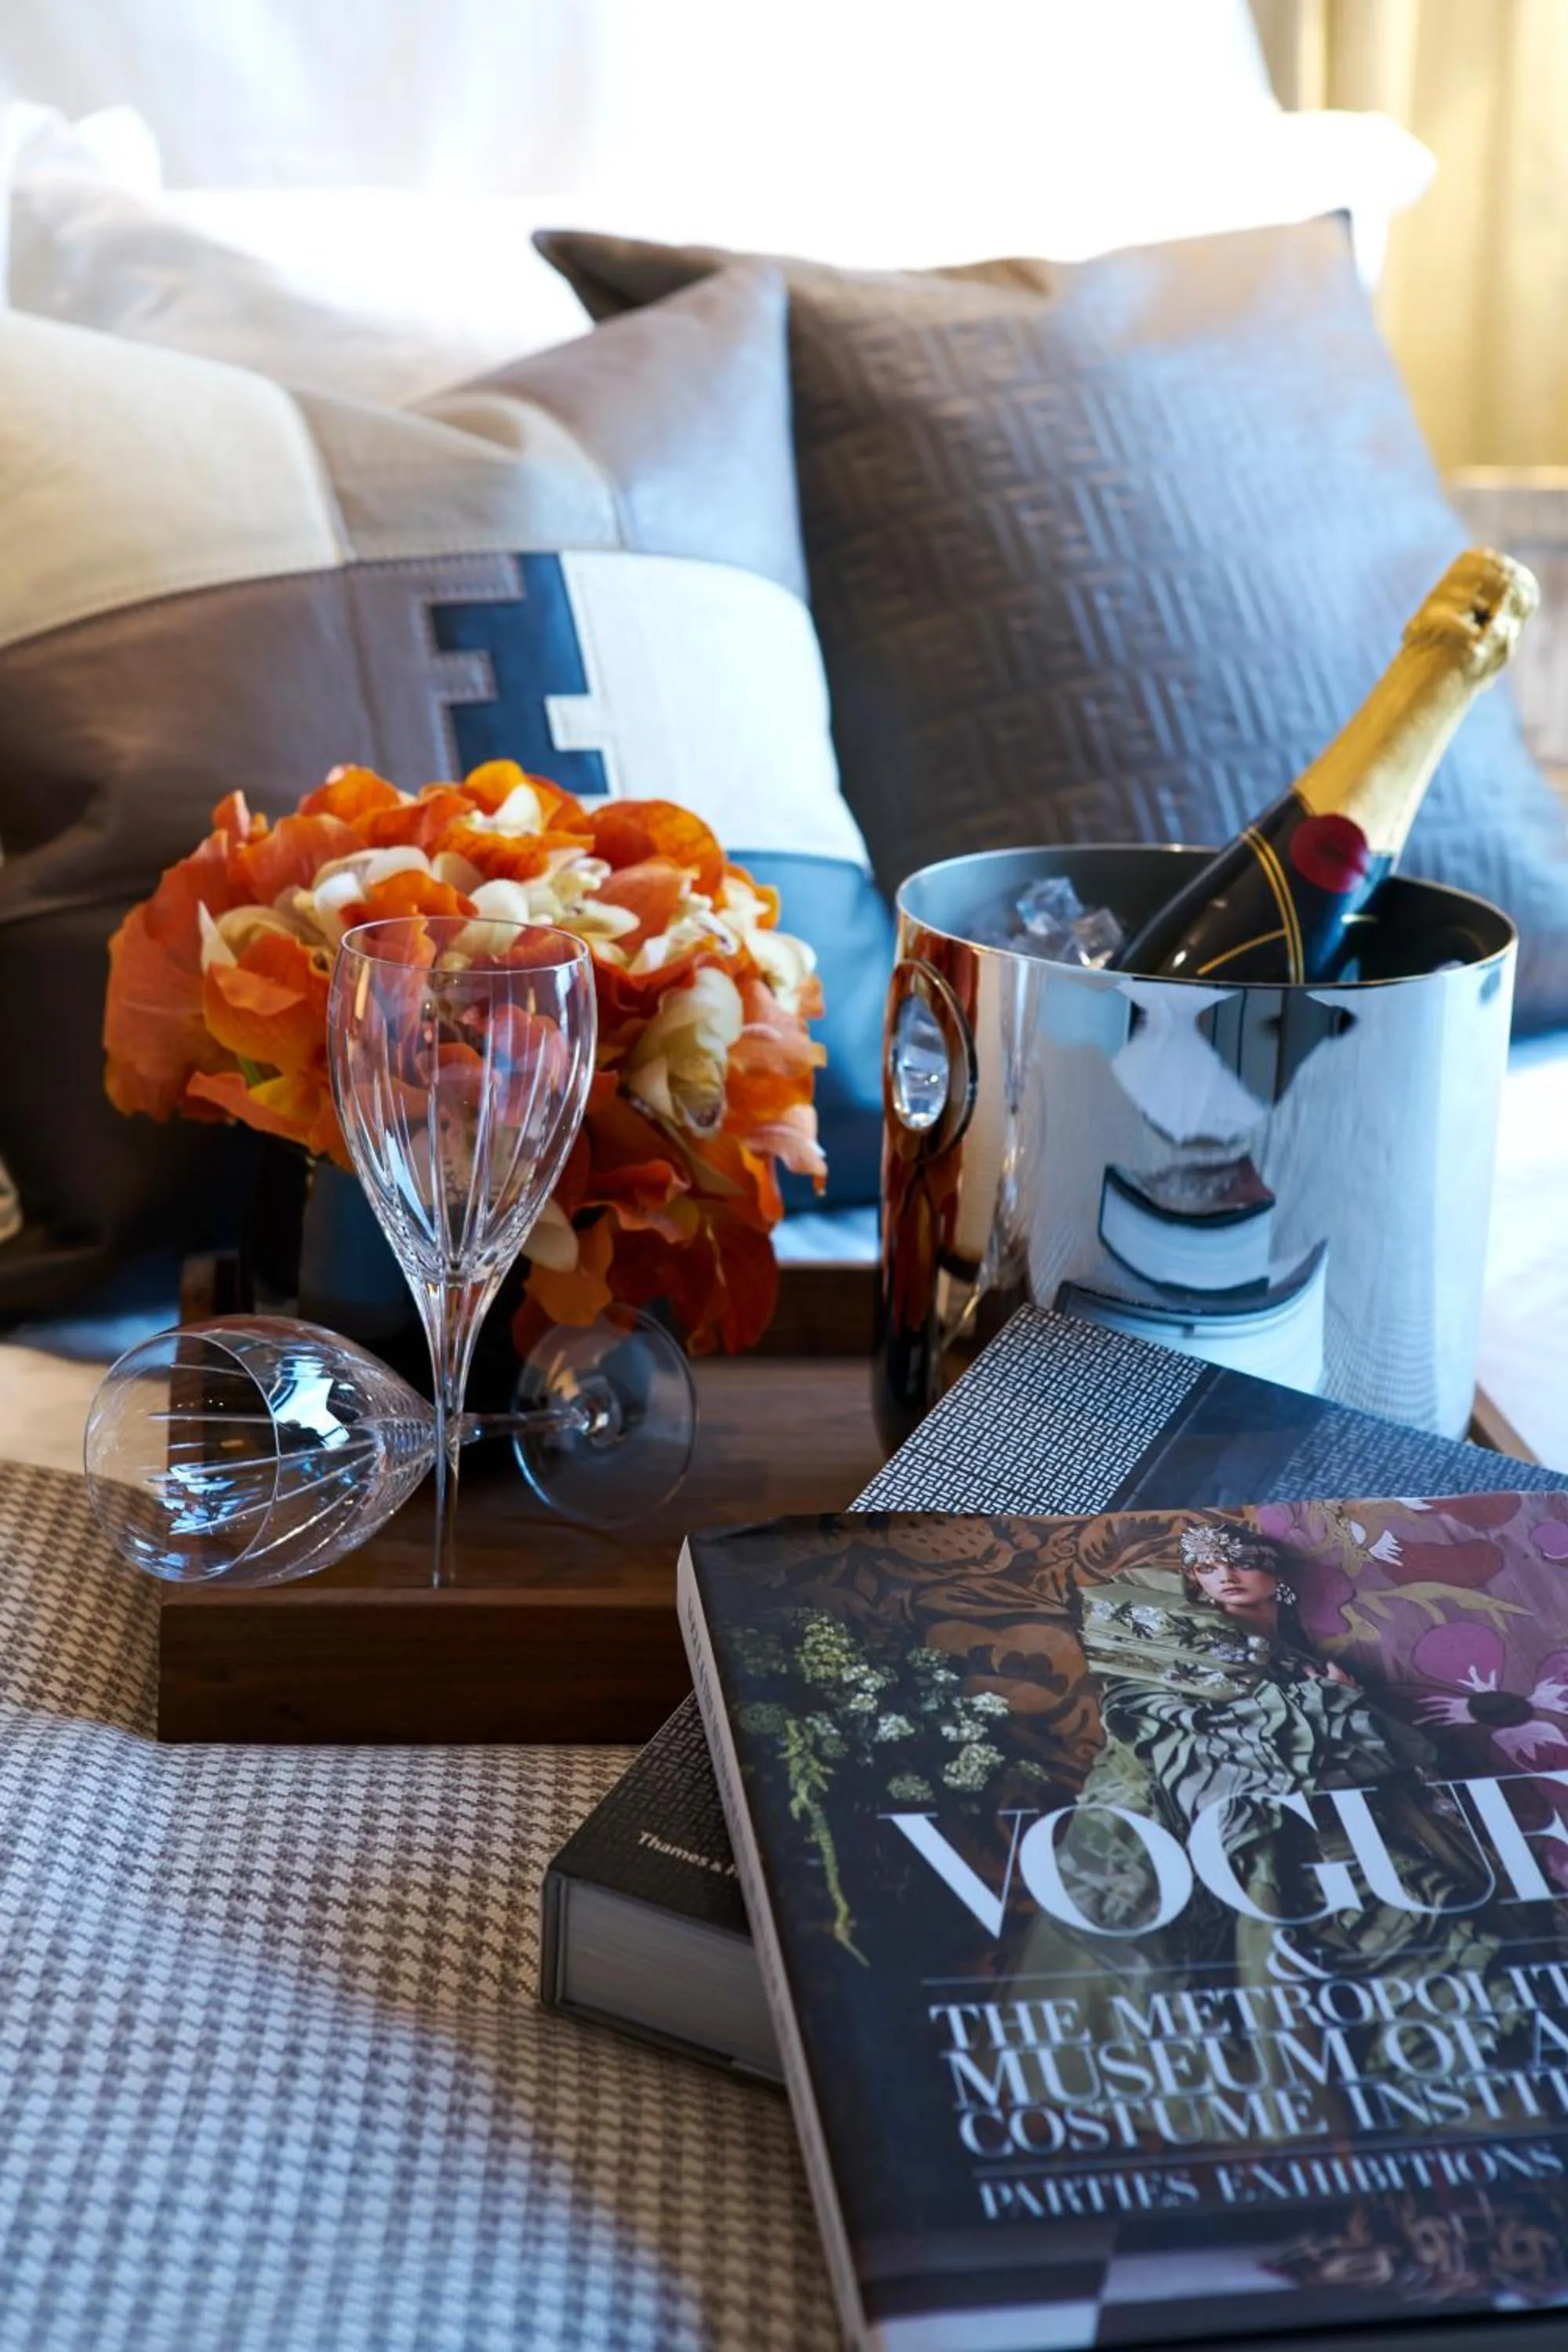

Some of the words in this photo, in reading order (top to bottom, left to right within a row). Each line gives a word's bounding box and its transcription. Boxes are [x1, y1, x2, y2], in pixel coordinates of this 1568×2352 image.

[638, 1831, 710, 1867] Thames
[877, 1769, 1568, 1940] VOGUE
[1266, 1928, 1338, 1981] &
[929, 1998, 1091, 2050] THE
[942, 2027, 1375, 2111] MUSEUM
[1383, 2013, 1501, 2082] OF
[958, 2087, 1328, 2158] COSTUME
[978, 2171, 1200, 2220] PARTIES
[1215, 2141, 1565, 2204] EXHIBITIONS
